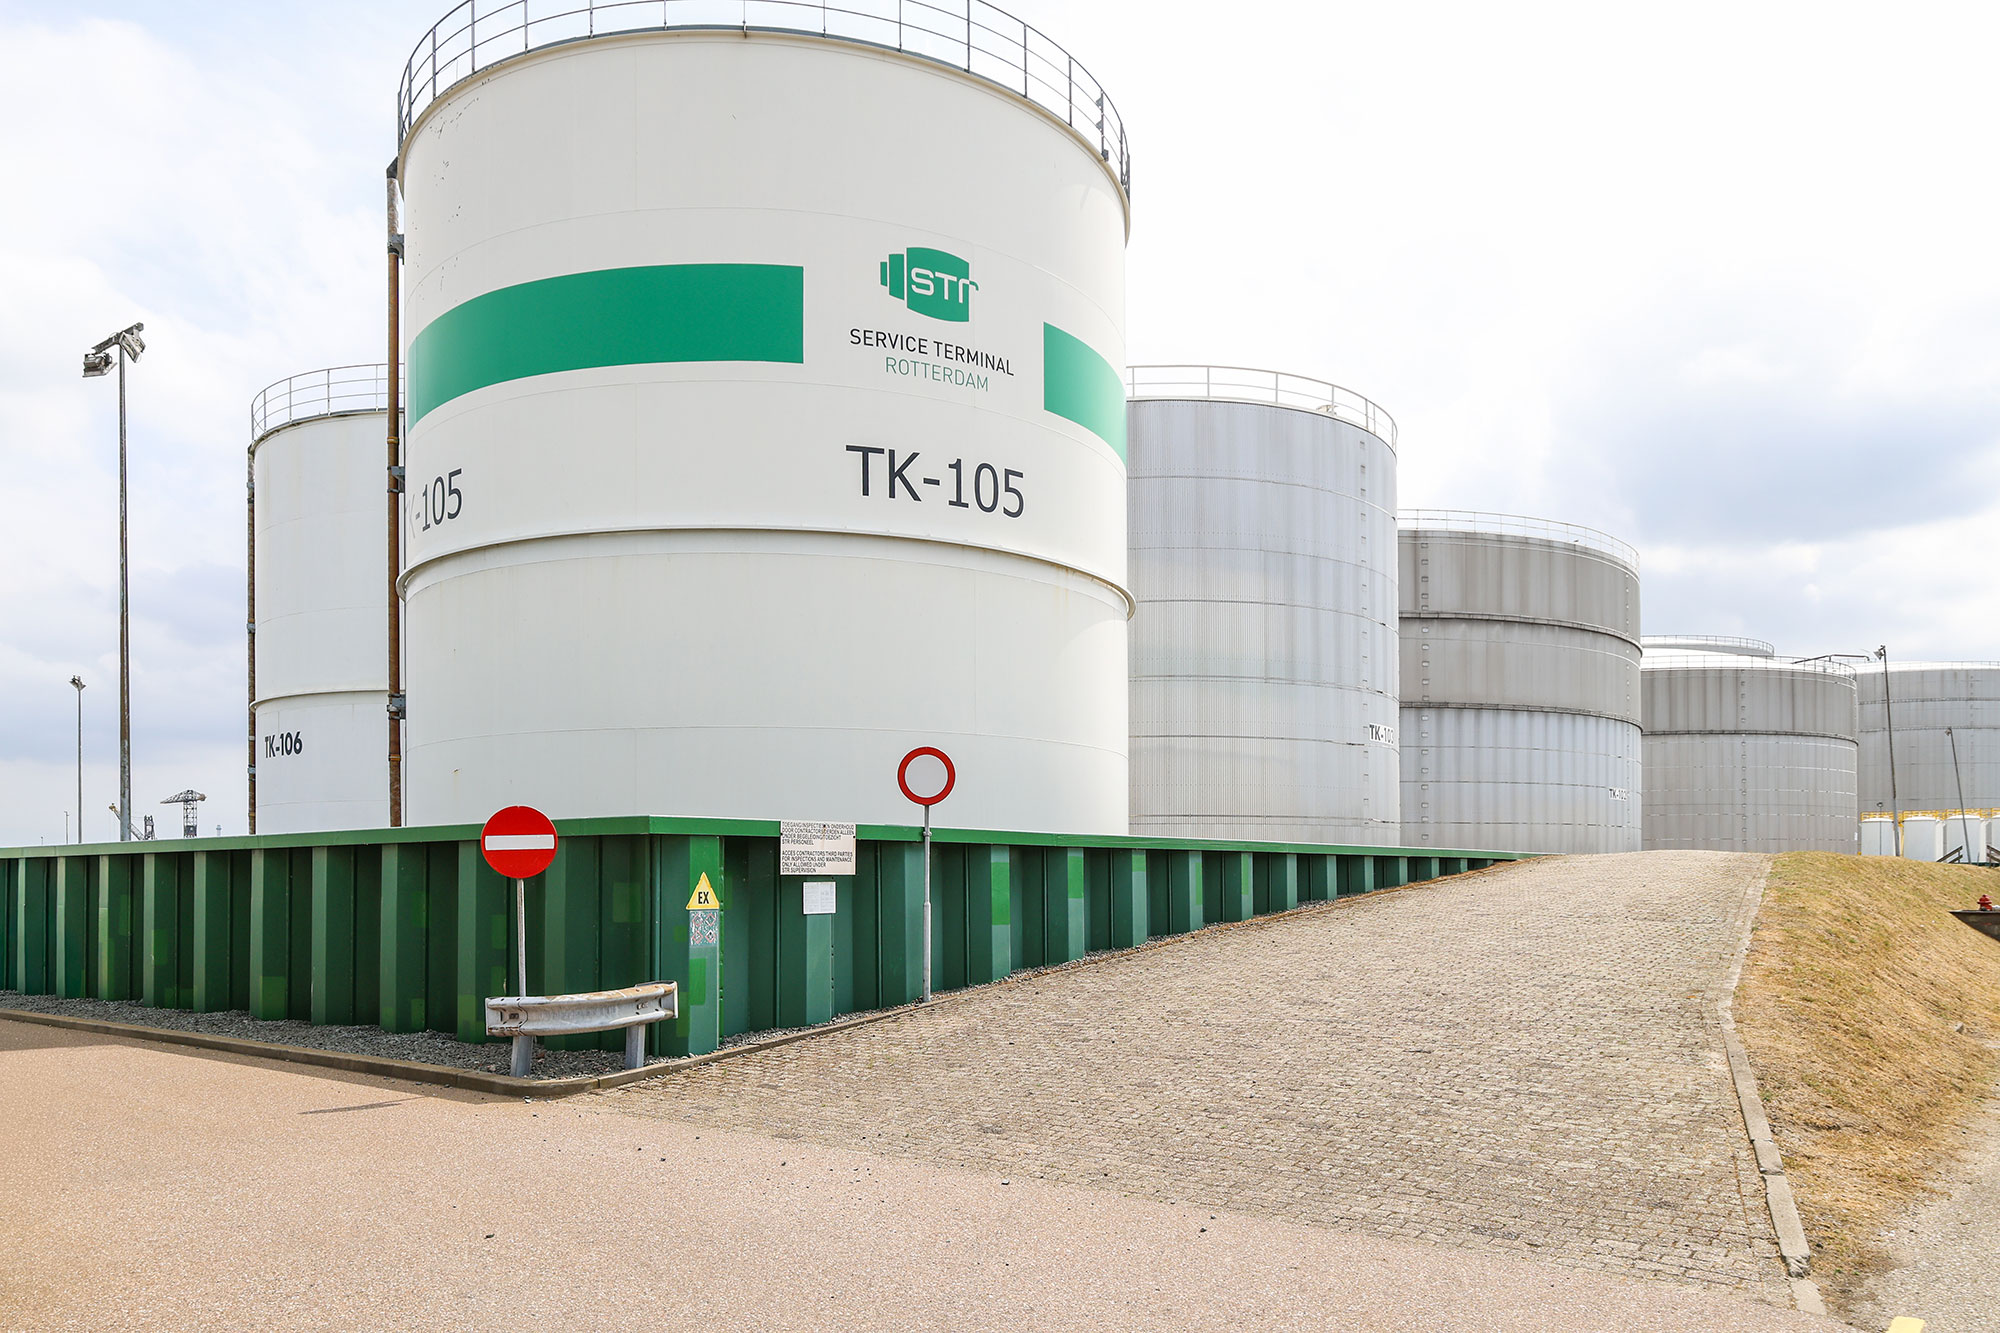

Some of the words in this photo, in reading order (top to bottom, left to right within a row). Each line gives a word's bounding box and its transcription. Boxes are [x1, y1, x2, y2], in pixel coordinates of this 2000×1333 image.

[849, 328, 928, 355] SERVICE
[933, 340, 1015, 377] TERMINAL
[885, 356, 989, 392] ROTTERDAM
[846, 444, 1024, 519] TK-105
[264, 731, 303, 758] TK-106
[698, 892, 709, 904] EX
